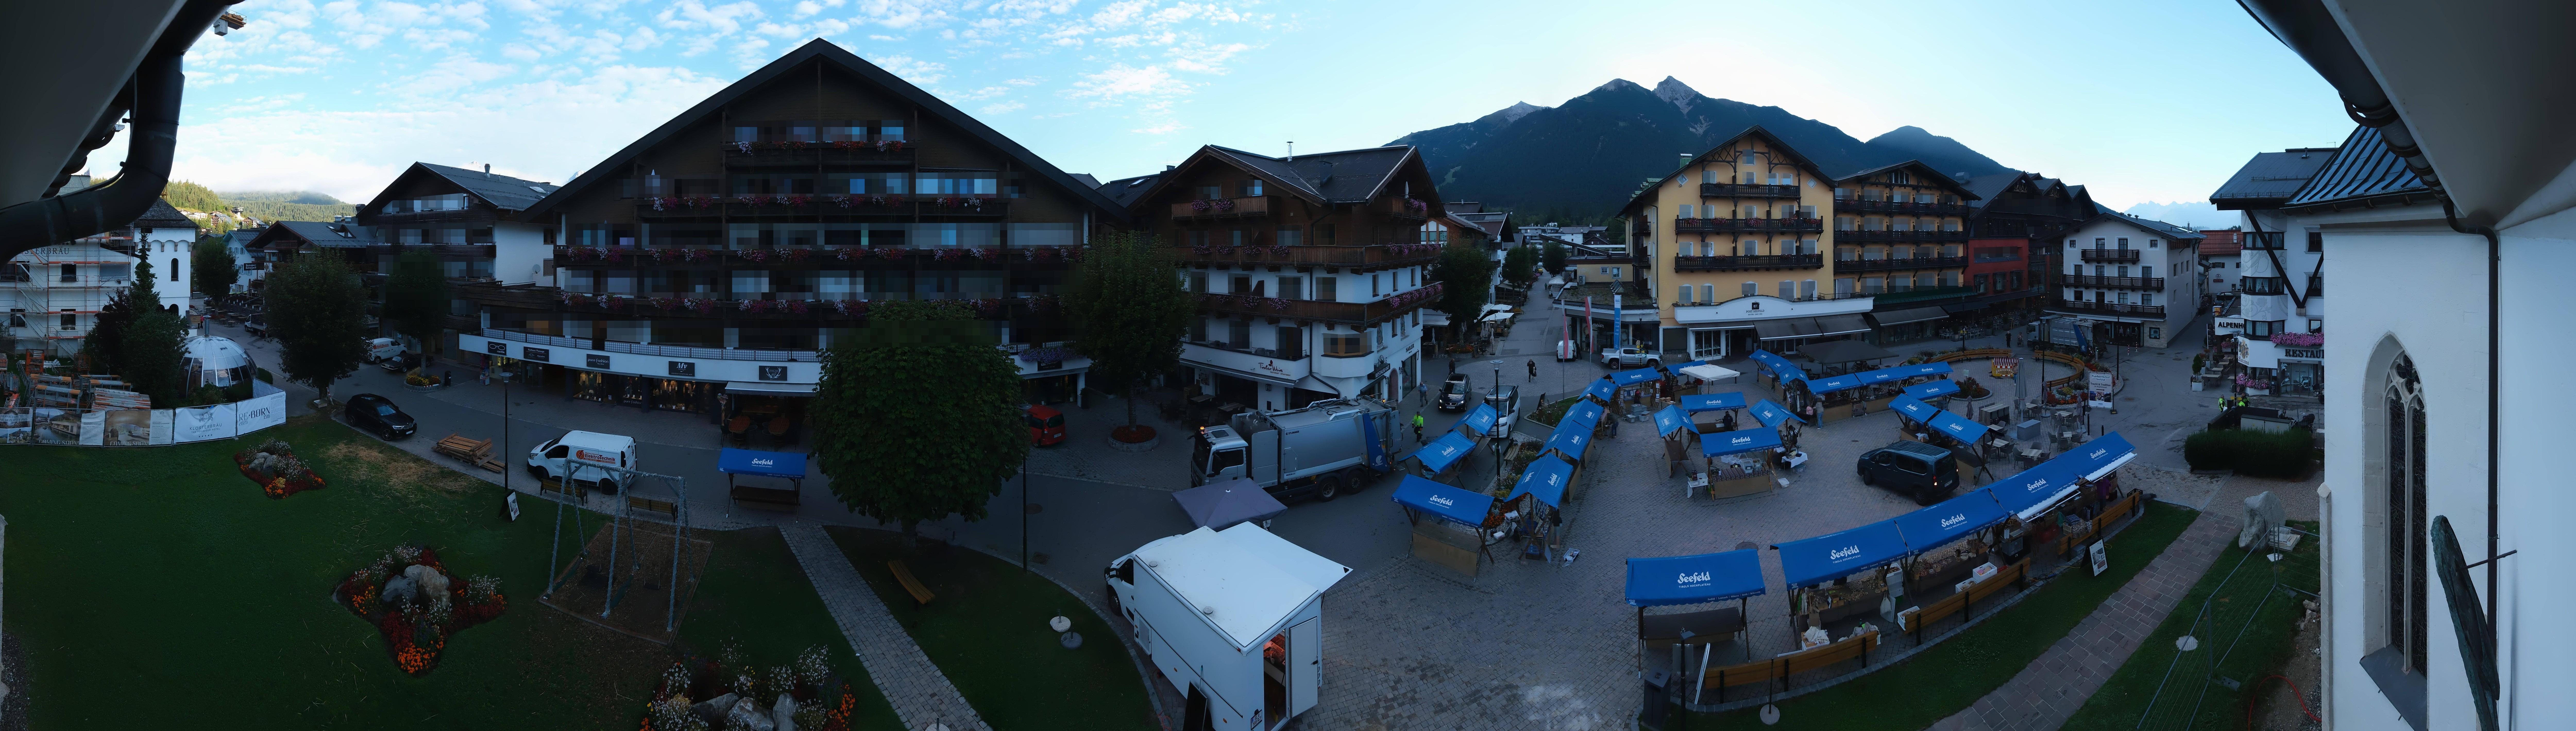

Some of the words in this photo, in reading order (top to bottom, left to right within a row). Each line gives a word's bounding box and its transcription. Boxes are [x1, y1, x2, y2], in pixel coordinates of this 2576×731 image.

[1406, 344, 1414, 352] SAILER
[1375, 365, 1389, 378] RESTAURANT
[1442, 446, 1454, 456] Seefeld
[2090, 448, 2106, 458] Seefeld
[1548, 473, 1557, 486] Seefeld
[2027, 478, 2046, 491] Seefeld
[1430, 495, 1453, 506] Seefeld
[1941, 513, 1965, 527] Seefeld
[1830, 545, 1859, 559] Seefeld
[1677, 571, 1710, 584] Seefeld
